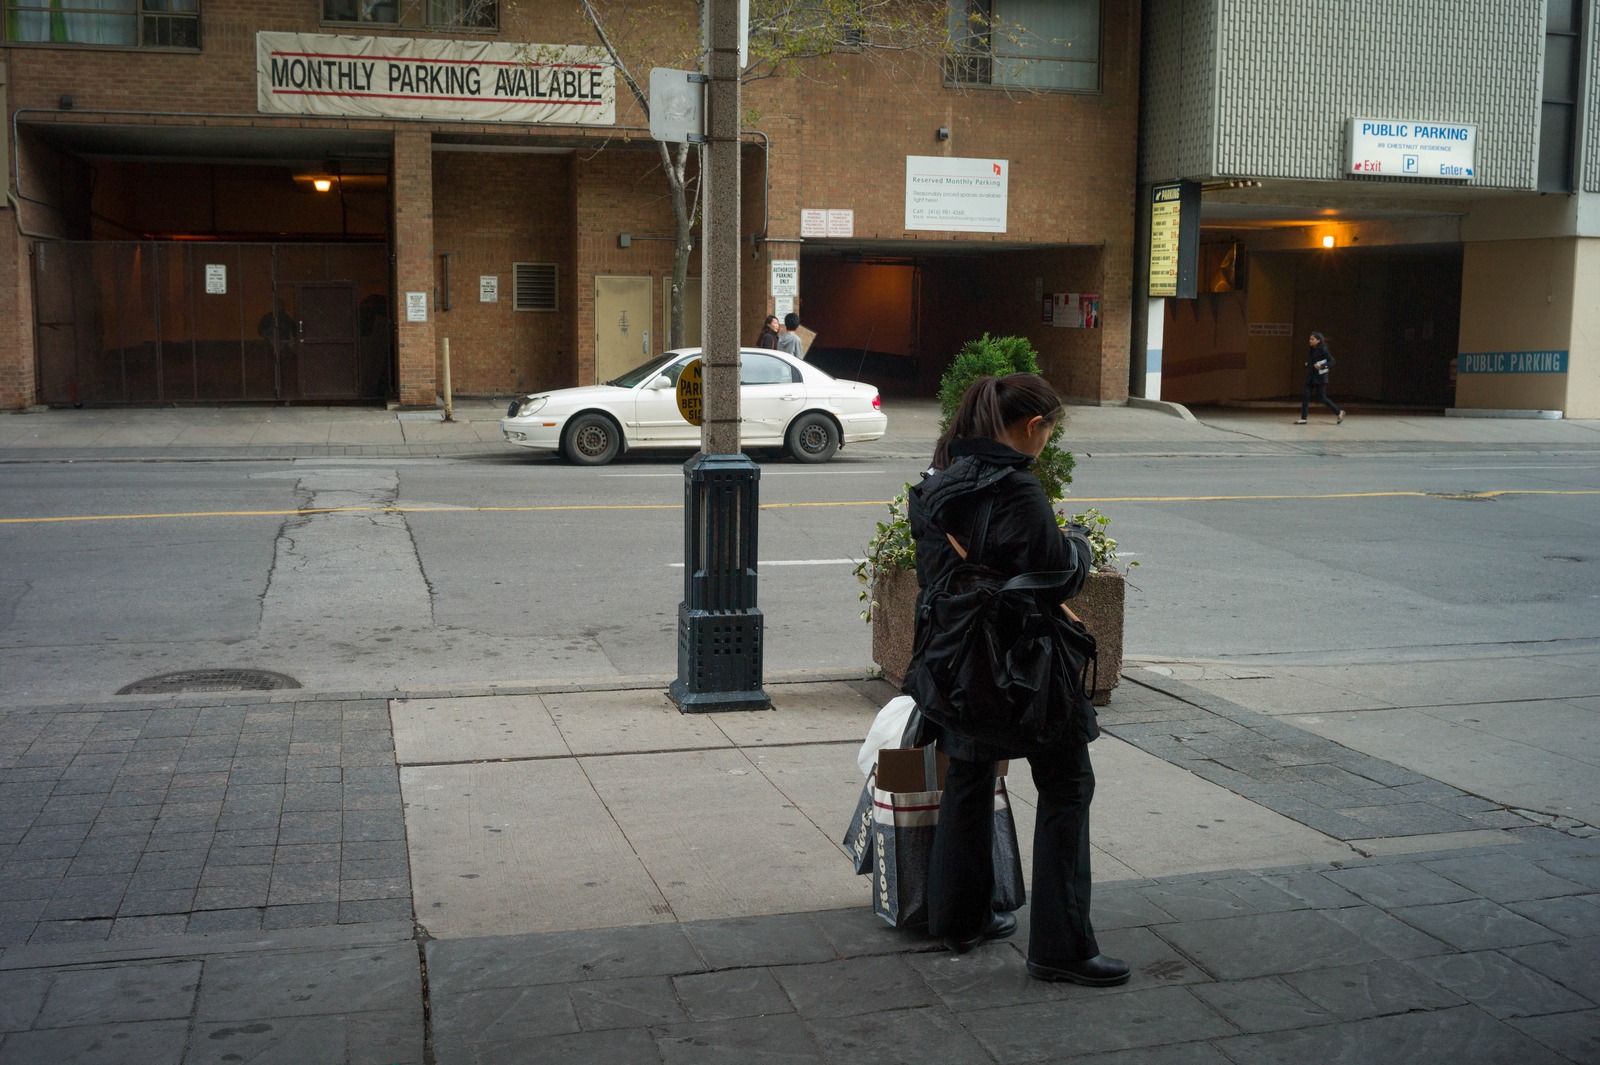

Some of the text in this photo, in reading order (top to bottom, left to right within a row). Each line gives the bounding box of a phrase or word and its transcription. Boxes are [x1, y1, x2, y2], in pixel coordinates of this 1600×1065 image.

[271, 58, 602, 99] MONTHLY PARKING AVAILABLE
[1362, 123, 1468, 141] PUBLIC PARKING
[1419, 144, 1452, 152] RESIDENCE
[1364, 160, 1382, 172] Exit
[1440, 164, 1463, 176] Enter
[912, 176, 1001, 187] Reserved Monthly Parking
[912, 190, 942, 198] Reasonably
[1465, 353, 1561, 372] PUBLIC PARKING
